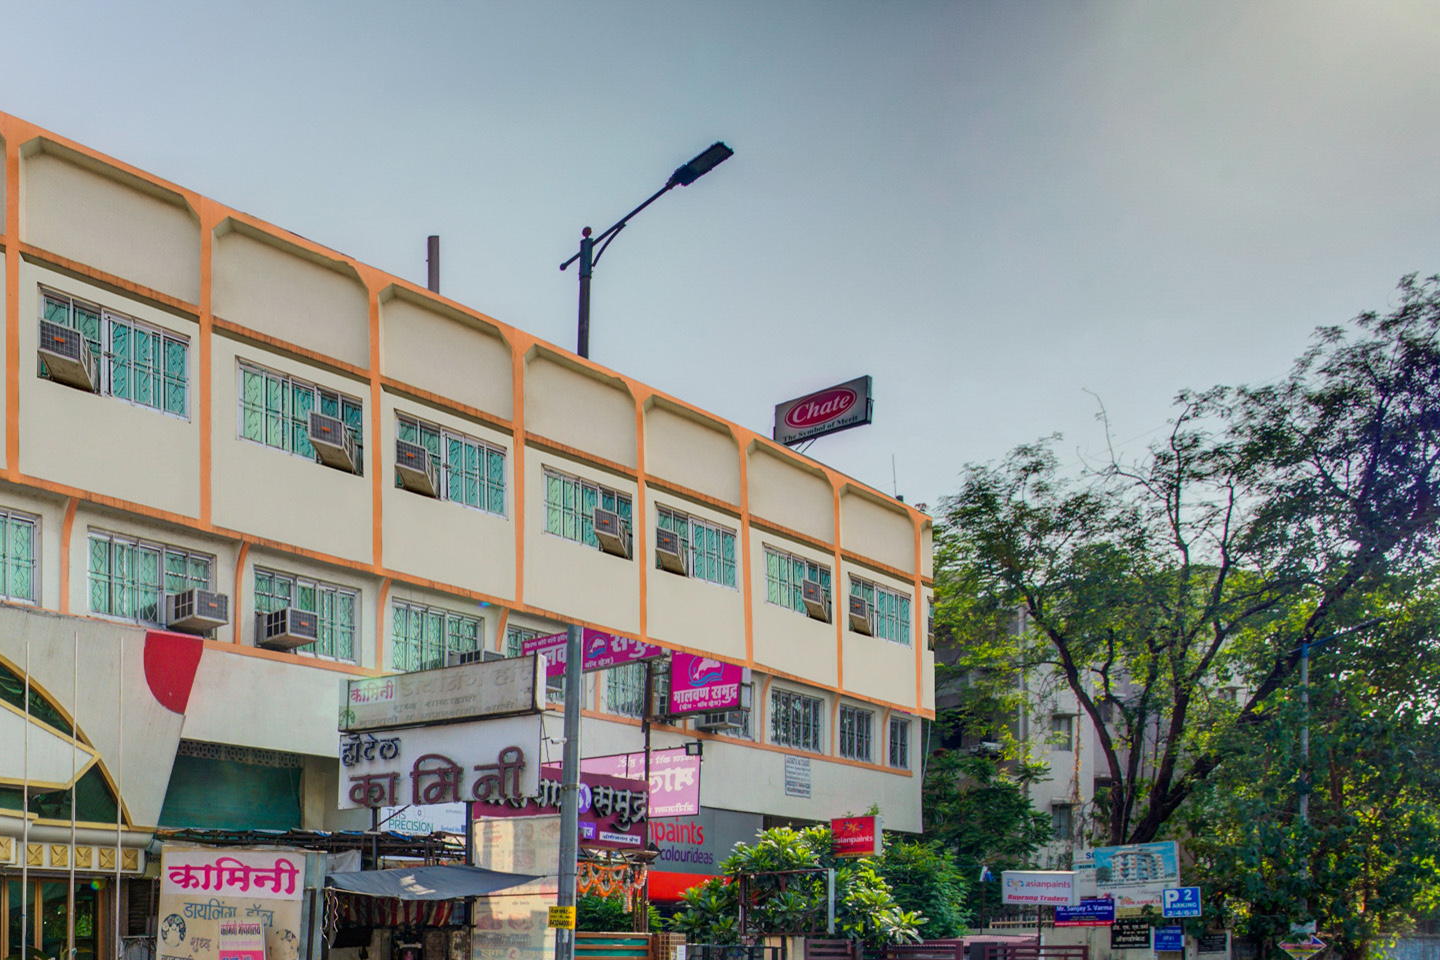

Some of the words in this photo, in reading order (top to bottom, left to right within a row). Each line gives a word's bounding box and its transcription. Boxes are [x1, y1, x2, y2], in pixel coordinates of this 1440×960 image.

[792, 395, 850, 423] Chate
[783, 434, 796, 442] The
[798, 425, 826, 438] Symbol
[827, 419, 835, 428] of
[836, 415, 858, 426] Merit
[350, 680, 395, 703] कामिनी
[673, 687, 710, 703] मालवण
[711, 683, 738, 703] समुद्र
[349, 746, 526, 807] कामिनी
[591, 785, 648, 831] समुद्र
[388, 819, 433, 832] PRECISION
[660, 845, 714, 865] colourideas
[168, 856, 299, 895] कामिनी
[1026, 880, 1071, 890] asianpaints
[1007, 894, 1038, 902] Ruprang
[1040, 894, 1068, 902] Traders
[1184, 889, 1192, 901] 2
